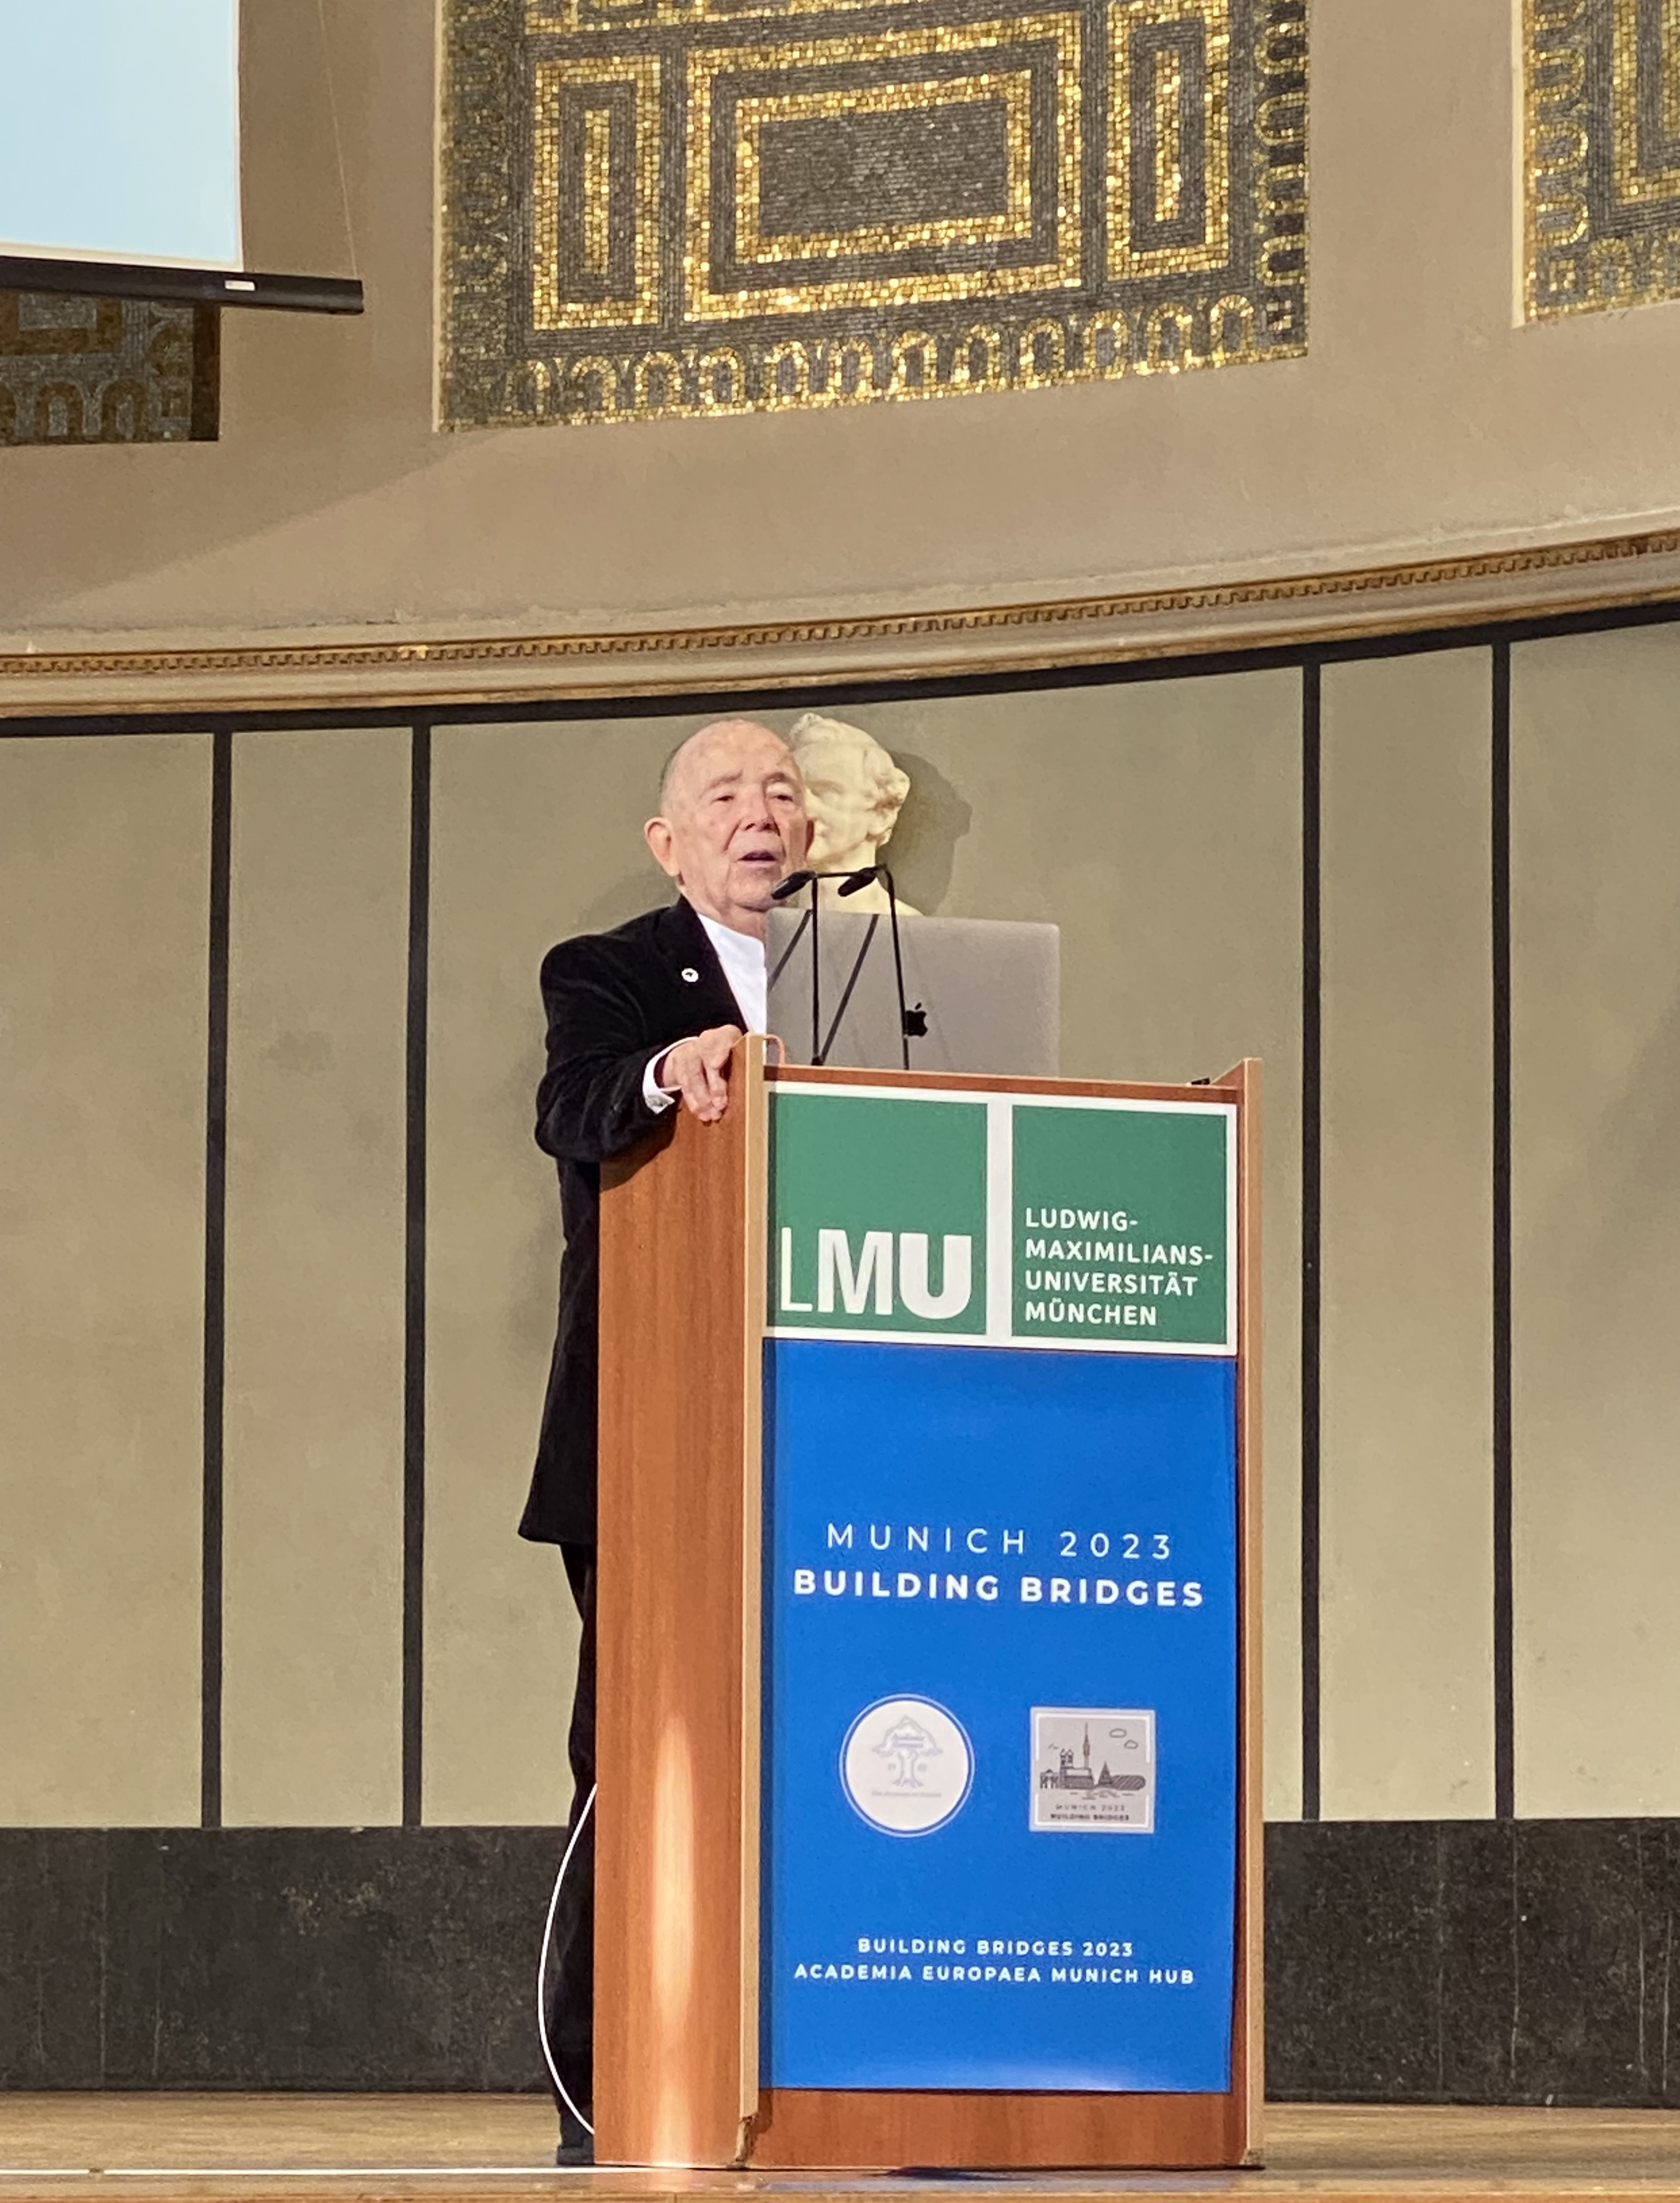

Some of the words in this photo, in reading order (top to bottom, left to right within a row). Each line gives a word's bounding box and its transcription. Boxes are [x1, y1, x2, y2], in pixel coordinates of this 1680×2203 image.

[1026, 1208, 1138, 1231] LUDWIG-
[1026, 1238, 1213, 1266] MAXIMILIANS-
[781, 1227, 972, 1319] LMU
[1026, 1270, 1198, 1296] UNIVERSITÄT
[1025, 1297, 1156, 1325] MÜNCHEN
[828, 1523, 1023, 1554] MUNICH
[1060, 1531, 1169, 1560] 2023
[794, 1569, 998, 1601] BUILDING
[1021, 1576, 1203, 1607] BRIDGES
[858, 1938, 966, 1955] BUILDING
[977, 1940, 1073, 1956] BRIDGES
[1083, 1941, 1132, 1957] 2023
[794, 1963, 912, 1980] ACADEMIA
[923, 1965, 1041, 1982] EUROPAEA
[1052, 1967, 1138, 1983] MUNICH
[1149, 1969, 1194, 1984] HUB
